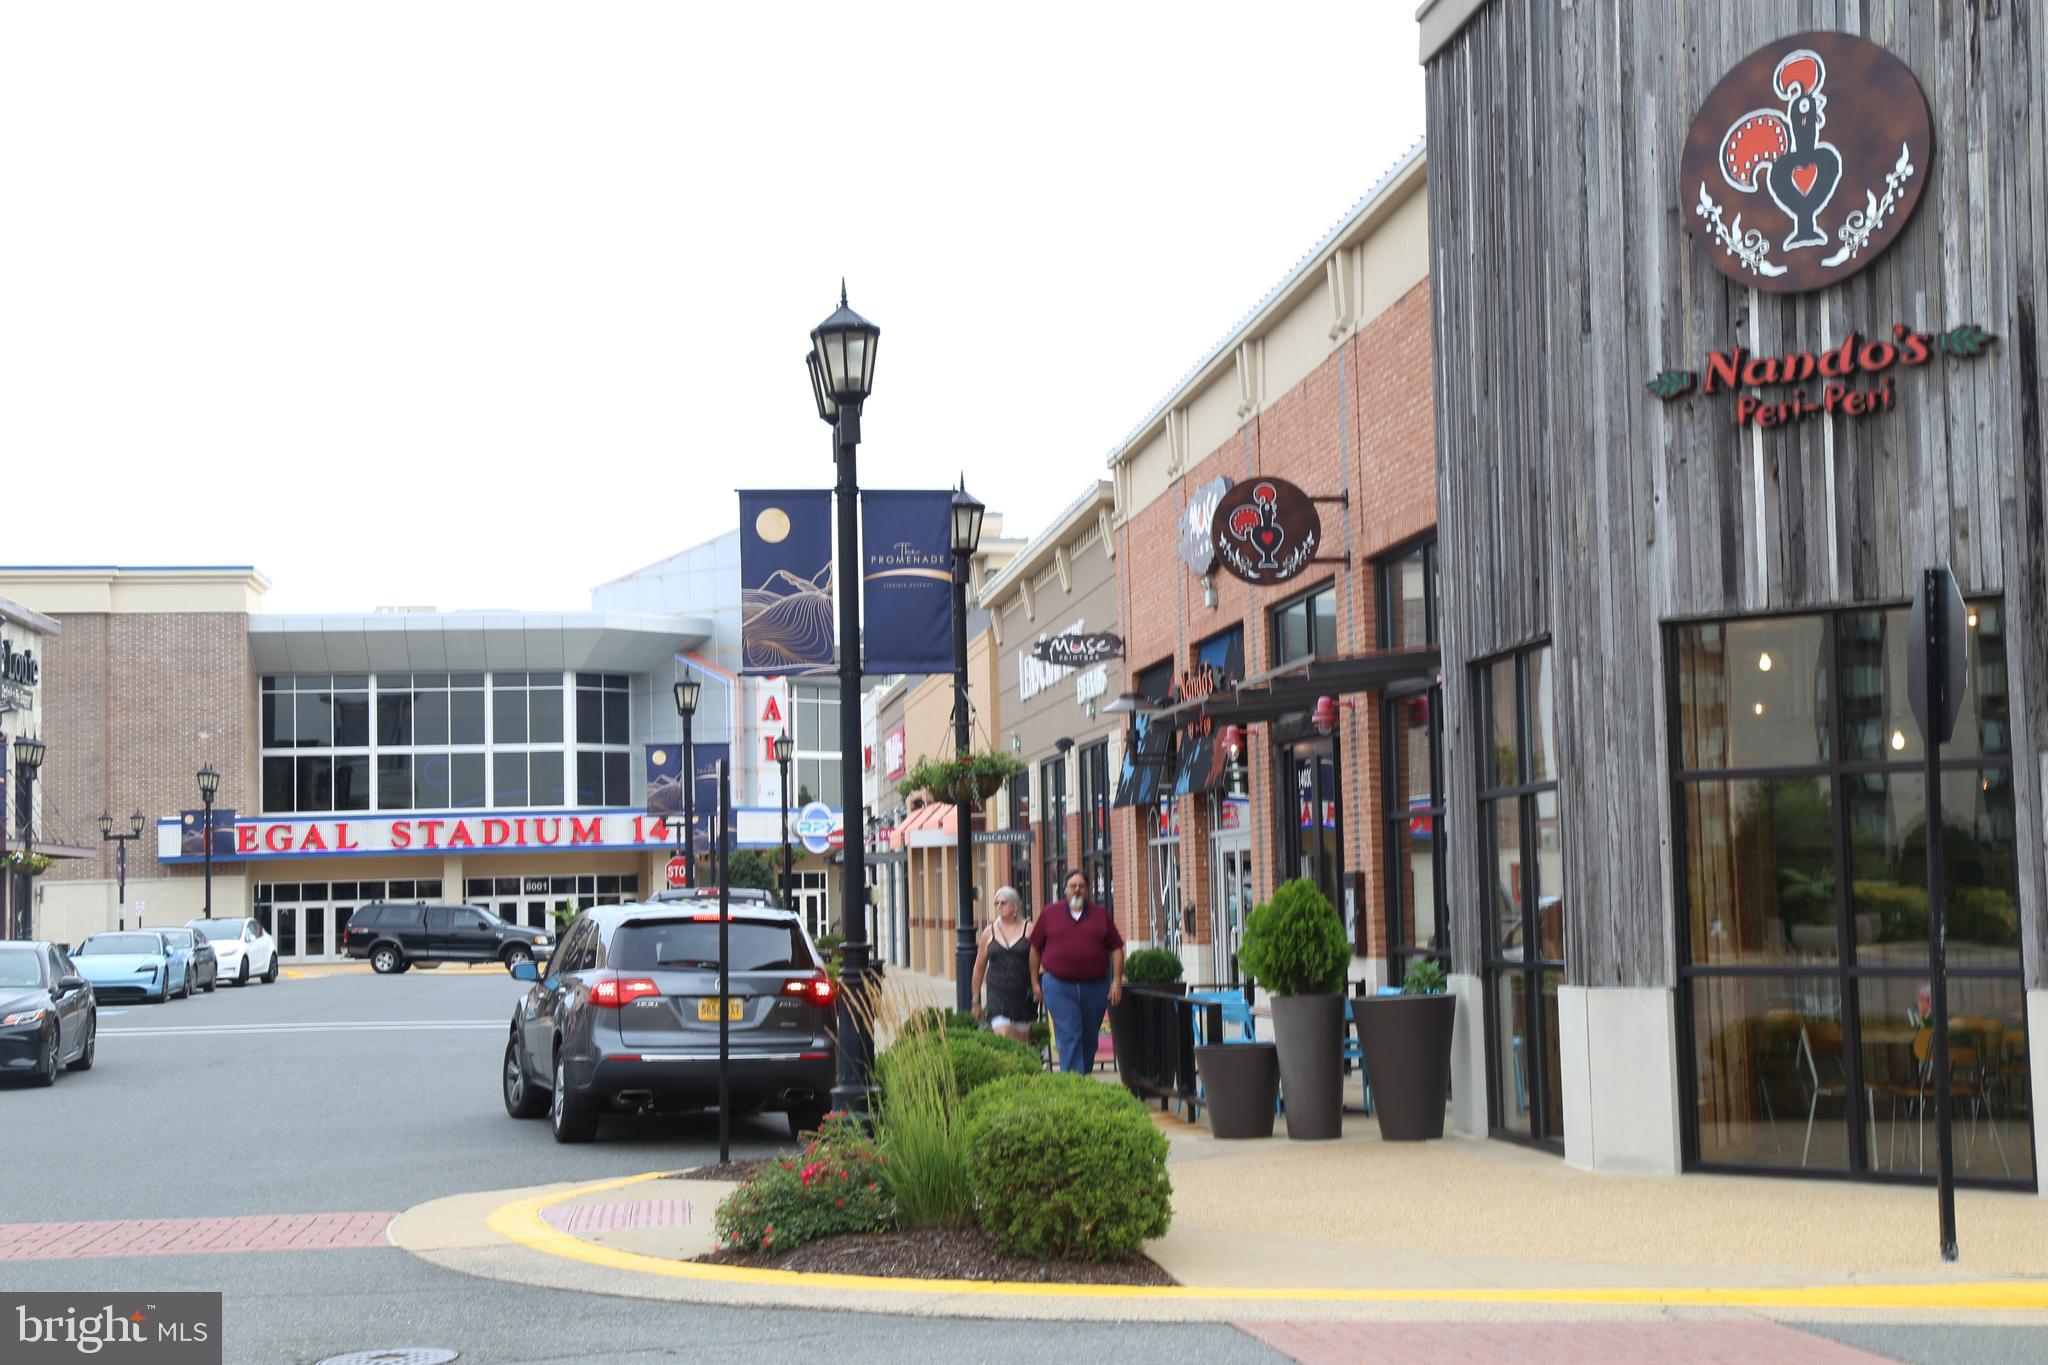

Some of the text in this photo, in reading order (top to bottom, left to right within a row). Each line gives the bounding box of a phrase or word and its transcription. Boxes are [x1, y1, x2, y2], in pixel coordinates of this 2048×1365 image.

[1704, 324, 1929, 392] Nando's
[1737, 377, 1889, 427] Peri-Peri
[871, 555, 945, 565] PROMENADE
[894, 542, 920, 561] The
[1180, 660, 1213, 705] Nando's
[236, 815, 670, 853] EGAL STADIUM 14
[667, 865, 686, 879] STO
